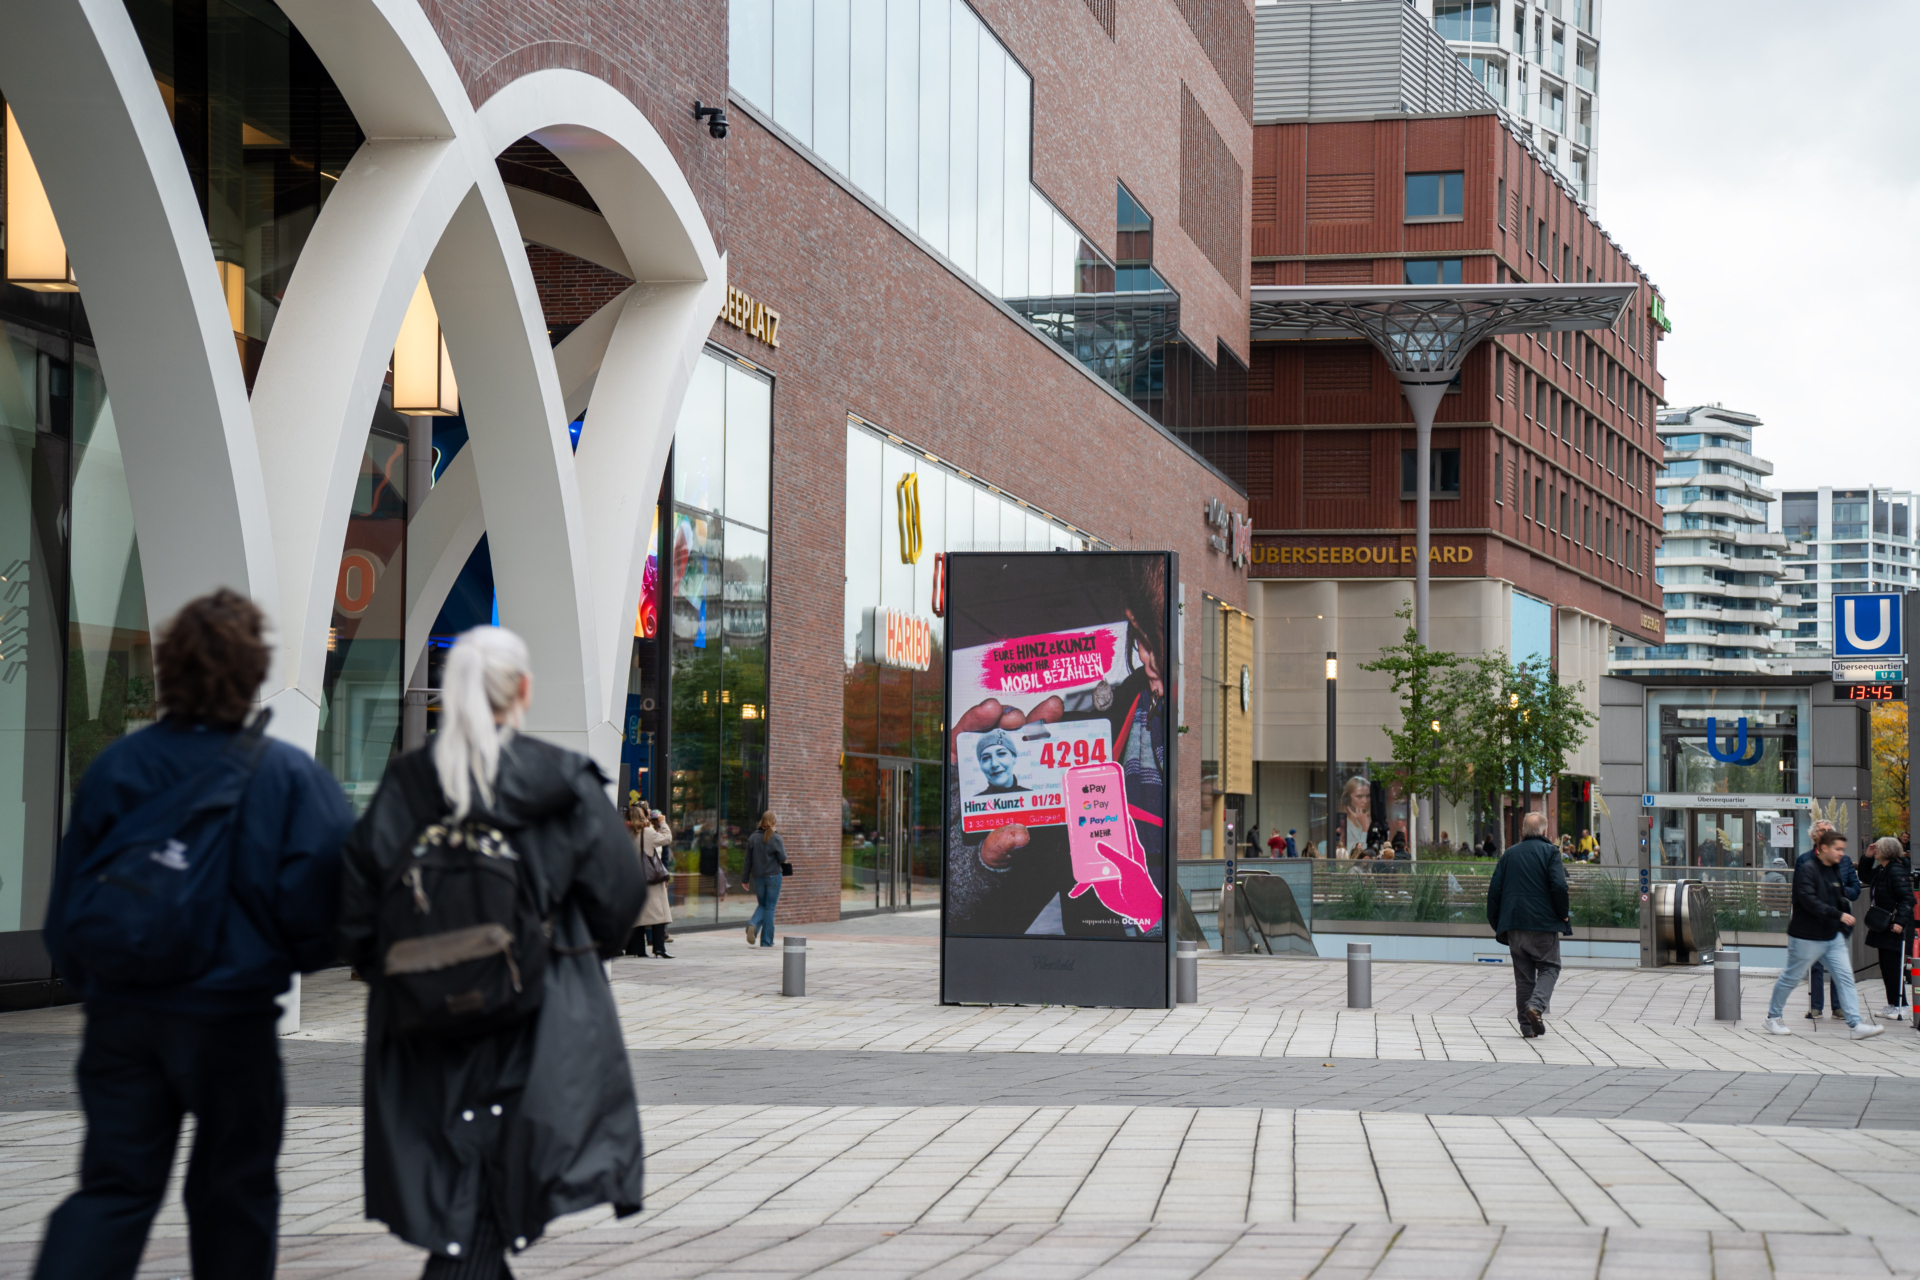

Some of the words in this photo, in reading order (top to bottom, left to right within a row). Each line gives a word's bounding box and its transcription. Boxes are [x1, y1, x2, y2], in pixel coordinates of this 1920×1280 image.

[1252, 544, 1473, 563] ÜBERSEEBOULEARD
[1844, 598, 1890, 650] U
[887, 611, 930, 666] HARIBO
[993, 649, 1015, 662] EURE
[1003, 662, 1033, 675] KÖNNT
[1035, 659, 1050, 671] IHR
[1052, 656, 1076, 669] JETZT
[1079, 652, 1101, 665] AUCH
[1833, 662, 1902, 671] Überseequartier
[1000, 673, 1043, 693] MOBIL
[1042, 663, 1104, 684] BEZAHLEN
[1849, 685, 1894, 700] 13:45
[1707, 717, 1747, 762] U
[1039, 738, 1107, 769] 4294
[1089, 784, 1106, 794] Pay
[964, 796, 1025, 813] Hinz&Kunzt
[1031, 793, 1062, 807] 01/29
[1093, 800, 1109, 810] Pay
[1090, 814, 1118, 824] PayPal
